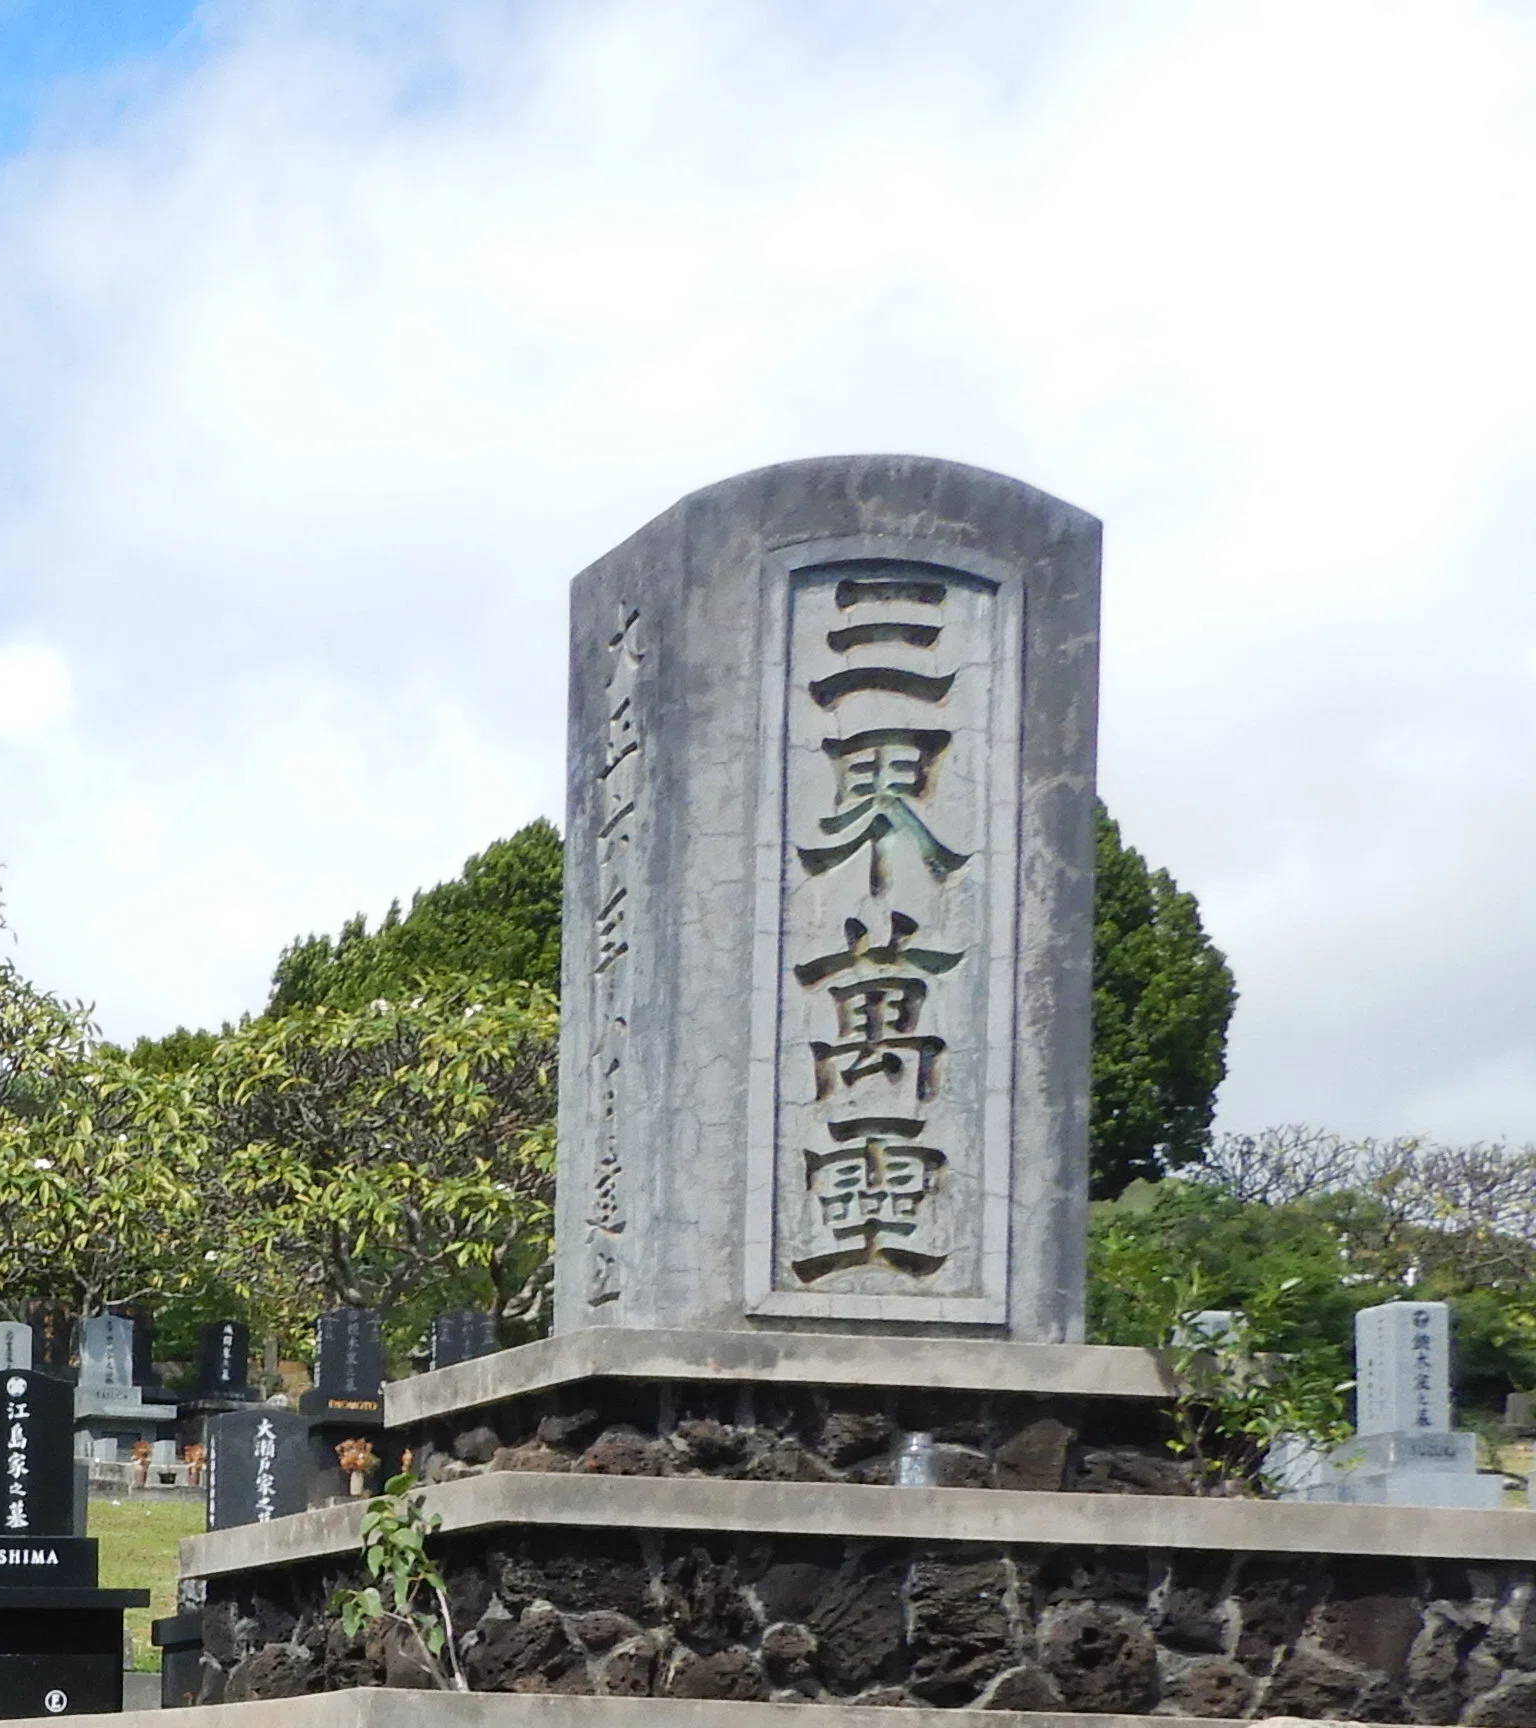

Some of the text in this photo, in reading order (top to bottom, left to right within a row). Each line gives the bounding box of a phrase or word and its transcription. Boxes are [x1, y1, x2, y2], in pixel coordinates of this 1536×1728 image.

[5, 1402, 31, 1529] 江島家之墓
